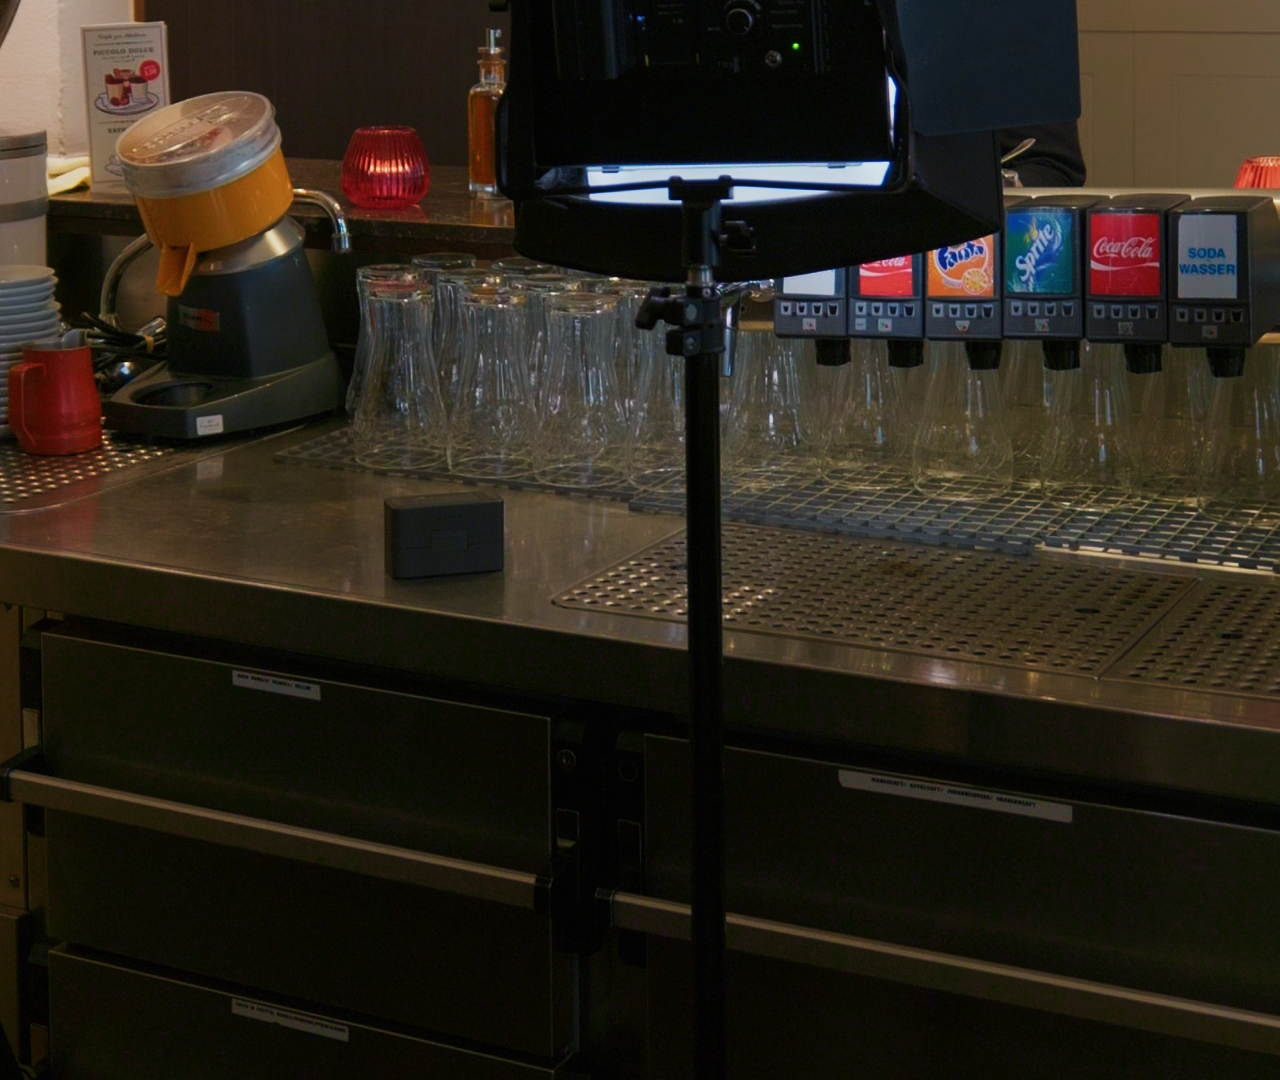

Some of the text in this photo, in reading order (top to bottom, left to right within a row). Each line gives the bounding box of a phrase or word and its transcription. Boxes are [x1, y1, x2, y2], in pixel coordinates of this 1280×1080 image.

[93, 48, 126, 56] PICCOLO
[937, 241, 985, 271] Fanta
[1016, 223, 1054, 282] Sprite
[1188, 247, 1225, 259] SODA
[1179, 264, 1236, 276] WASSER
